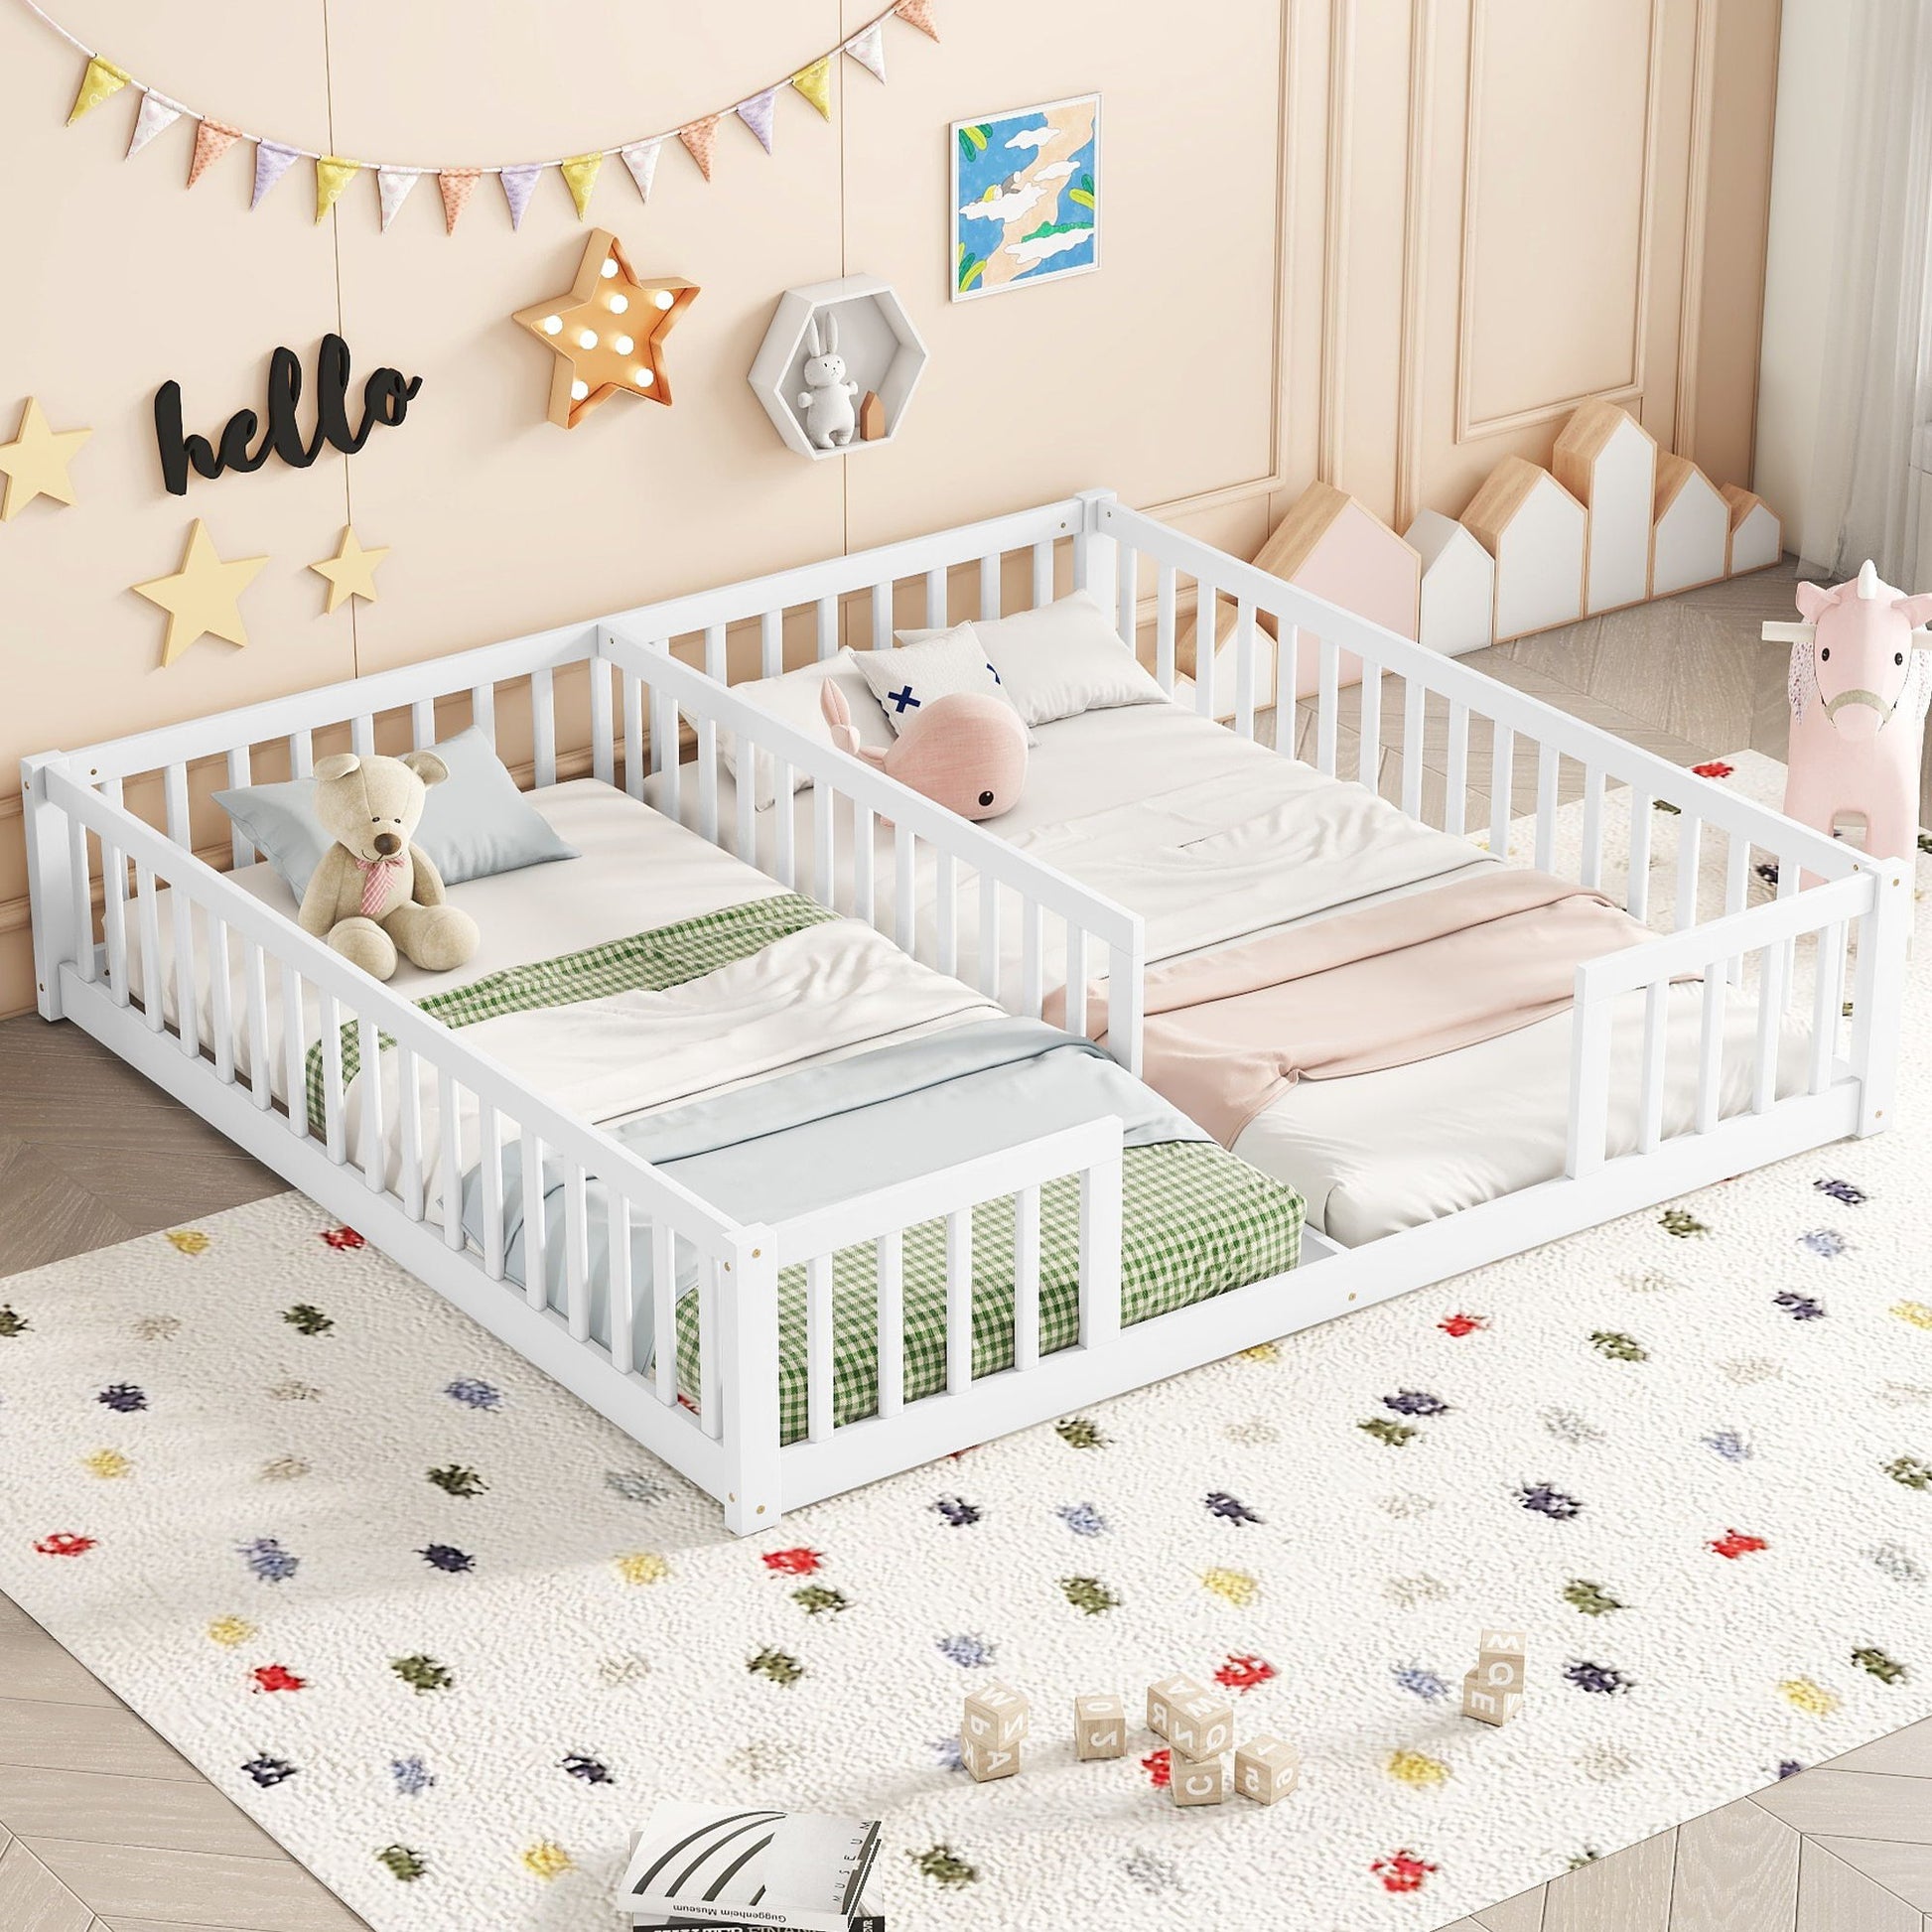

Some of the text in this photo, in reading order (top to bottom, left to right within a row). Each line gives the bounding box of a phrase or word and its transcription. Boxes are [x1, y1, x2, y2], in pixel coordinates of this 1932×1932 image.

[154, 333, 424, 496] hello
[672, 1903, 787, 1924] Guggenheim Museum
